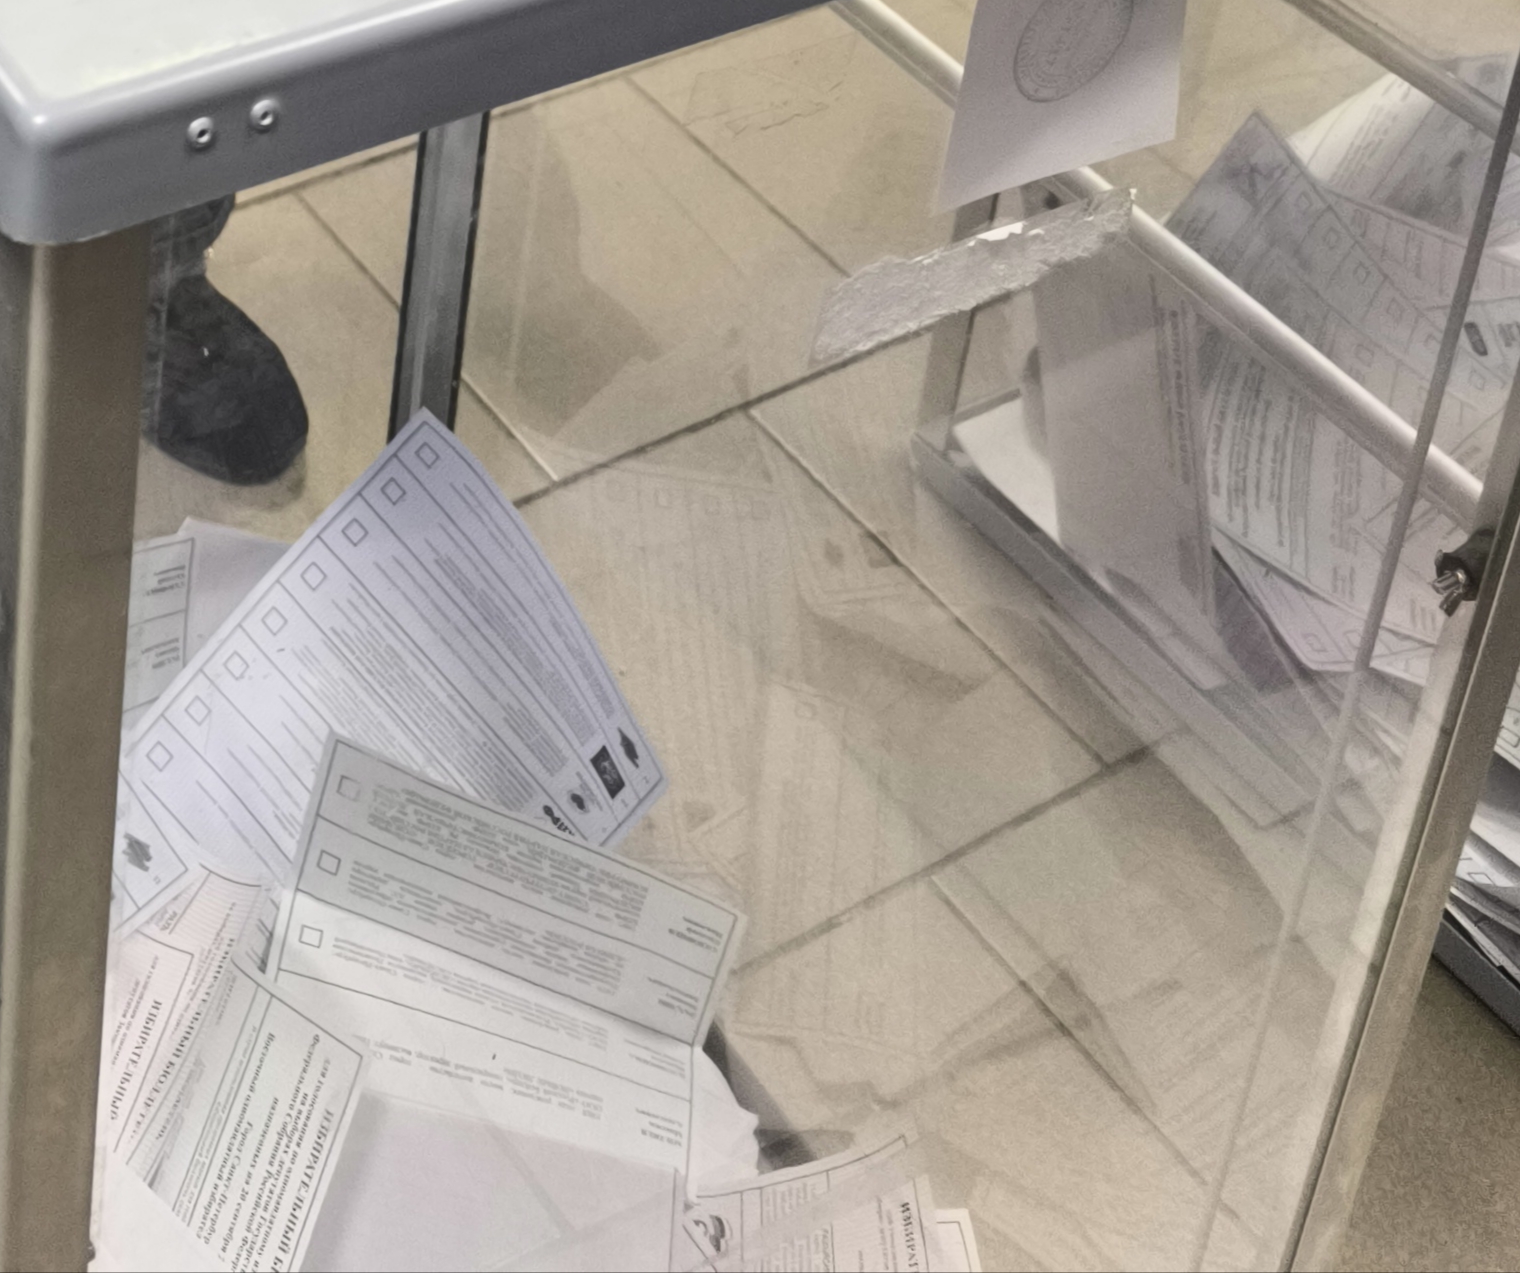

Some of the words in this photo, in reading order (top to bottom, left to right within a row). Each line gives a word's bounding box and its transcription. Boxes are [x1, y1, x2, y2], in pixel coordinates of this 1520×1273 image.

[248, 1032, 275, 1092] Восточный
[131, 1060, 176, 1137] БЮЛЛЕТЕ
[278, 1108, 333, 1253] ИЗБИРАТЕЛЬНЫЙ
[220, 1202, 241, 1252] сентября
[231, 1235, 248, 1273] Федер
[238, 1215, 266, 1273] Государст
